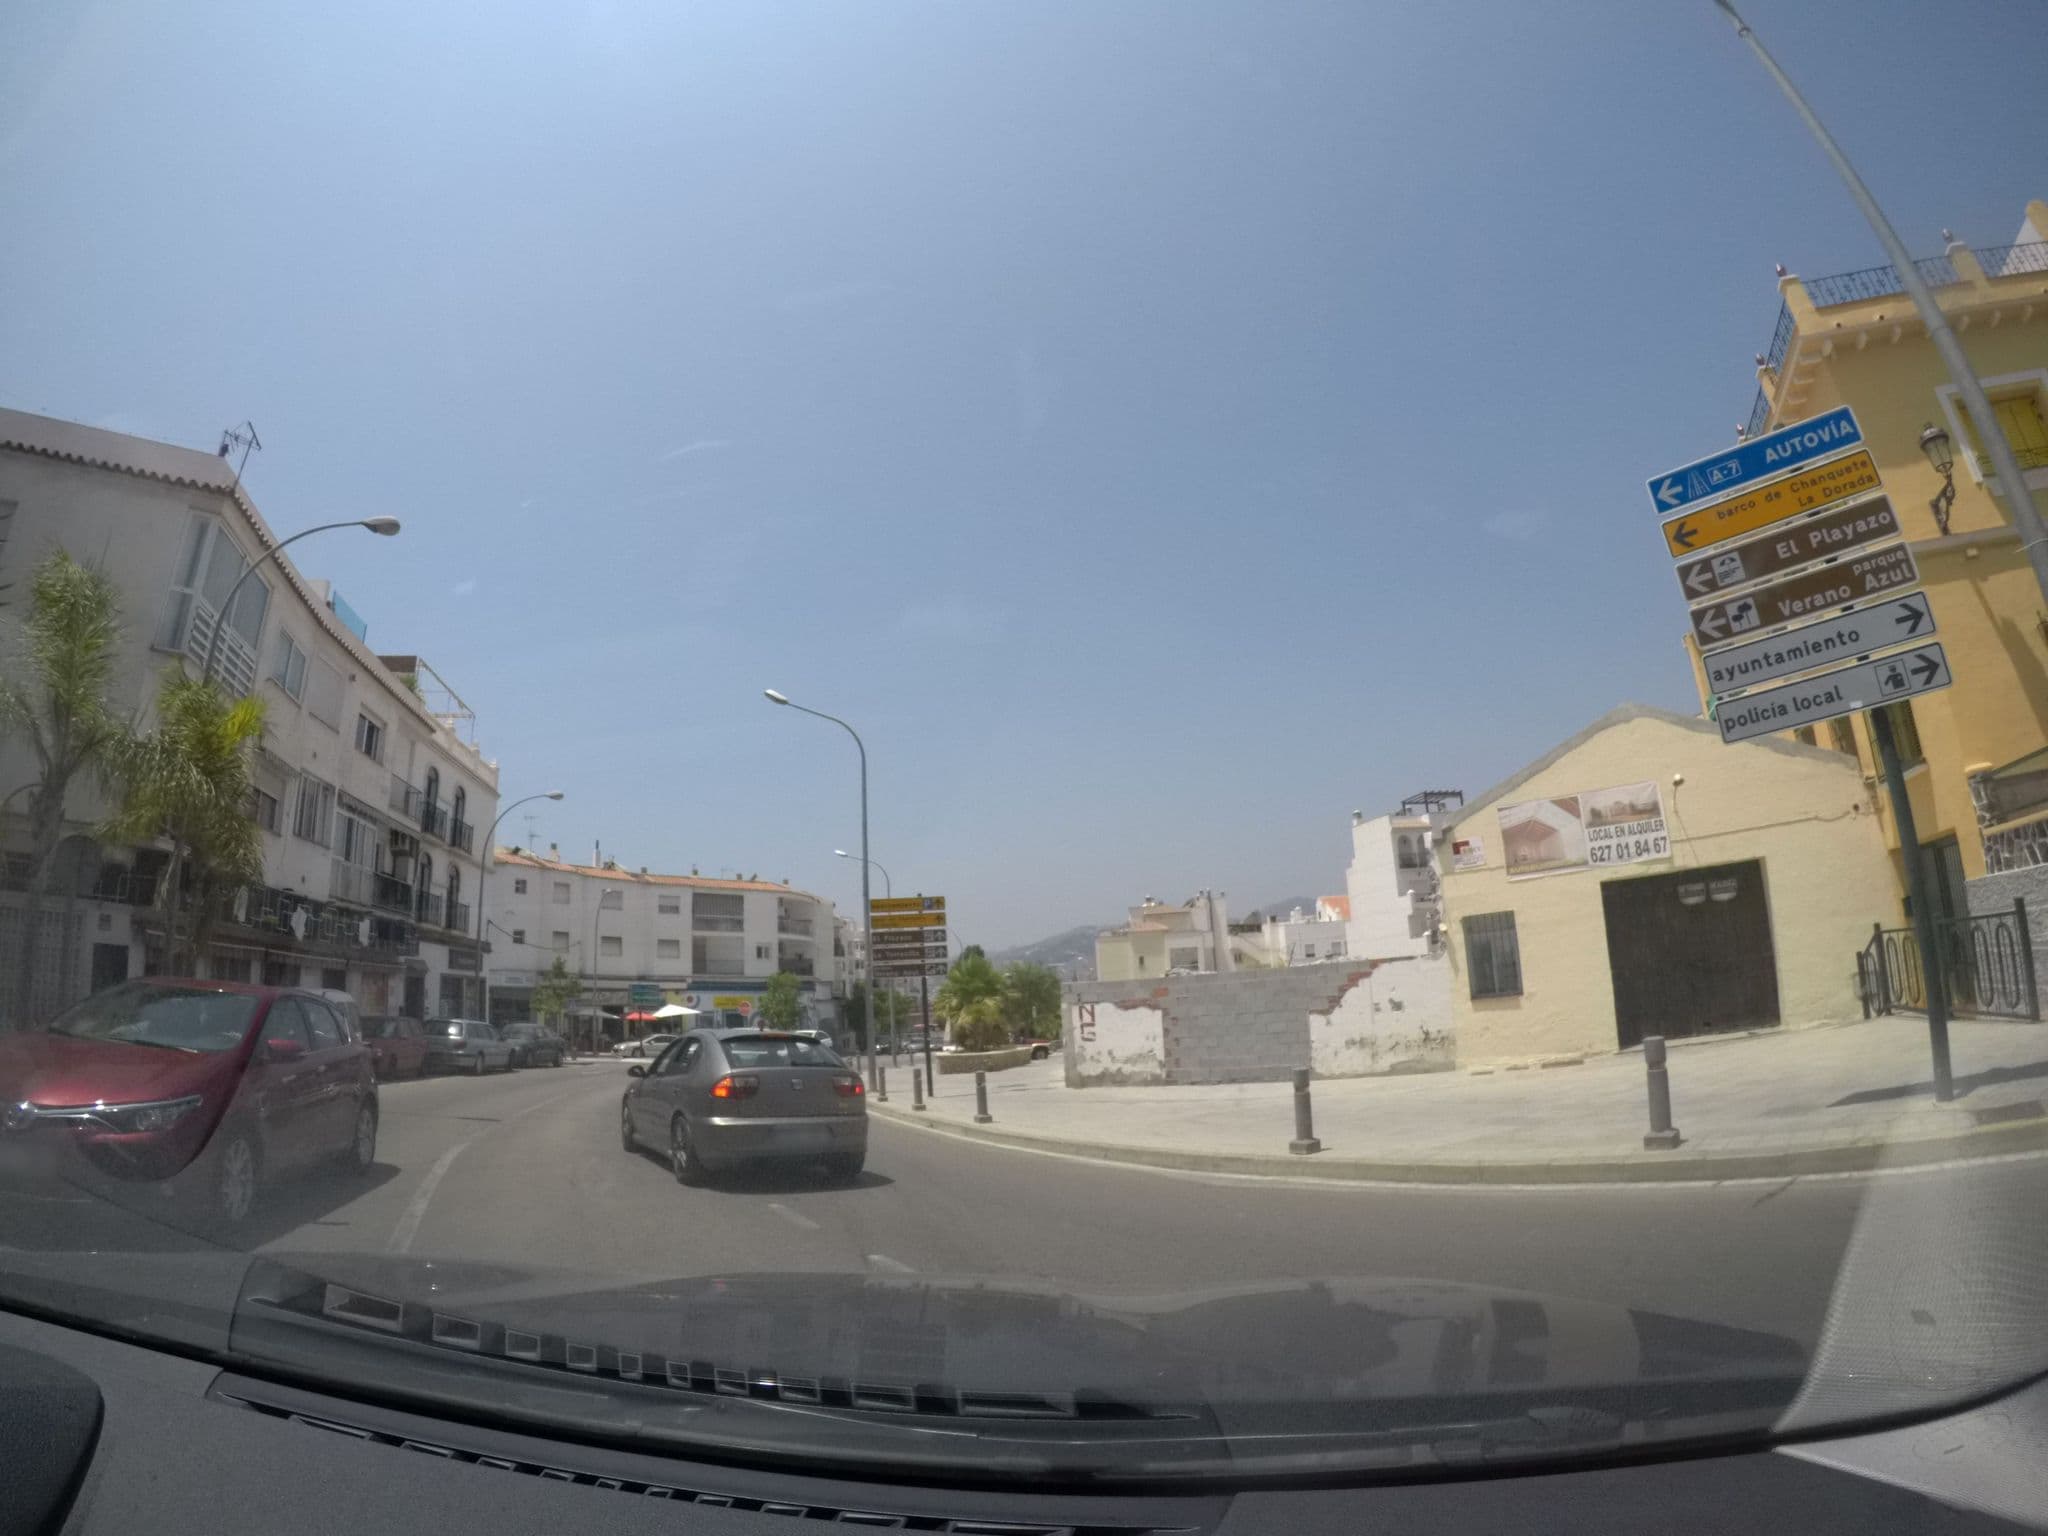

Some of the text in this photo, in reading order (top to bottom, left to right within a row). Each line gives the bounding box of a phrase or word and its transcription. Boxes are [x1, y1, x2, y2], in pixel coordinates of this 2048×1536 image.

[1711, 419, 1854, 482] A-7 AUTOVÍA
[1717, 457, 1869, 521] barco de Chanquete
[1798, 473, 1874, 508] La Dorada
[1776, 510, 1892, 560] El Playazo
[1852, 549, 1906, 577] parque
[1777, 564, 1913, 618] Verano Azul
[1712, 629, 1861, 683] ayuntamiento
[1792, 685, 1844, 713] local
[1588, 819, 1664, 842] LOCAL EN ALQUILER
[1590, 836, 1668, 863] 627 01 84 67
